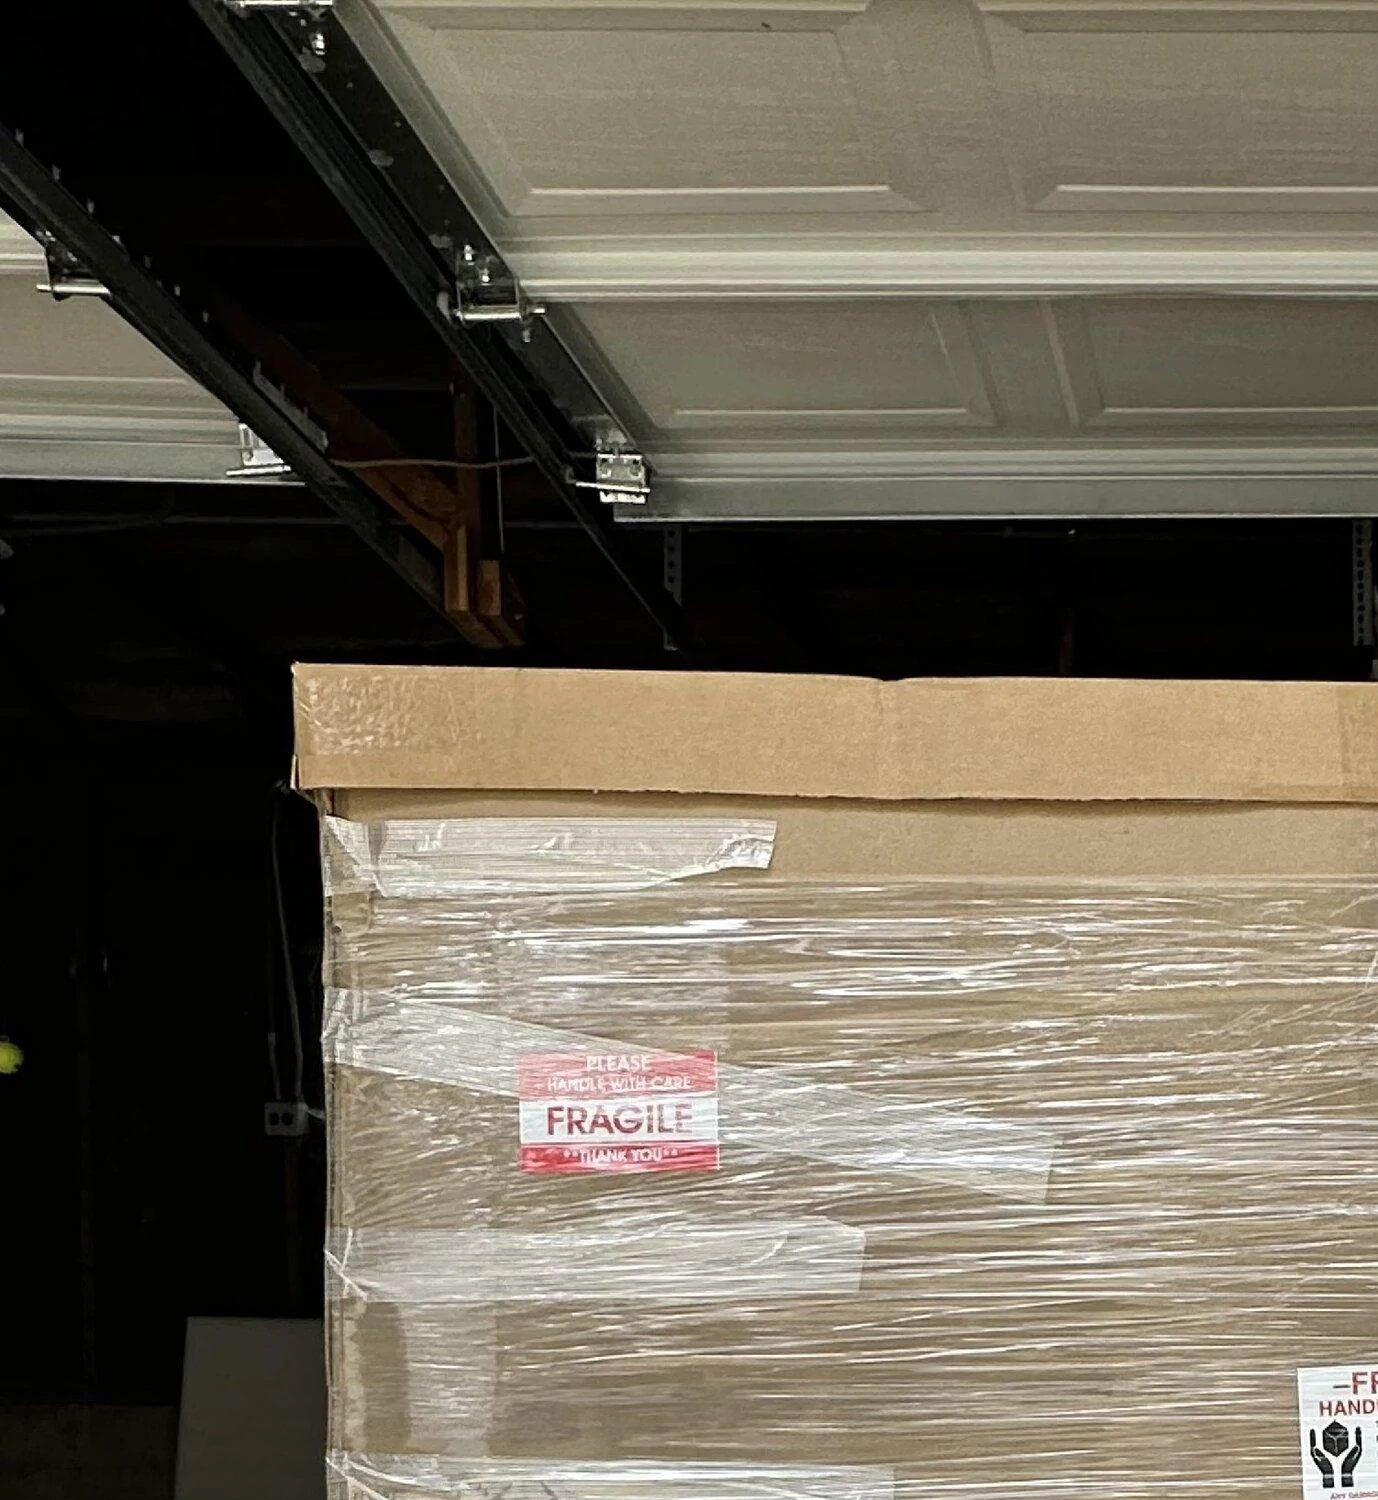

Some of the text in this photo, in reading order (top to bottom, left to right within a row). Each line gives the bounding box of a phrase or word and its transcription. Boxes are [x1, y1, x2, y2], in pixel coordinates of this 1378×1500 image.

[586, 1055, 651, 1071] PLEASE
[547, 1075, 693, 1093] HANDLE WITH CARE
[547, 1103, 693, 1135] FRAGILE
